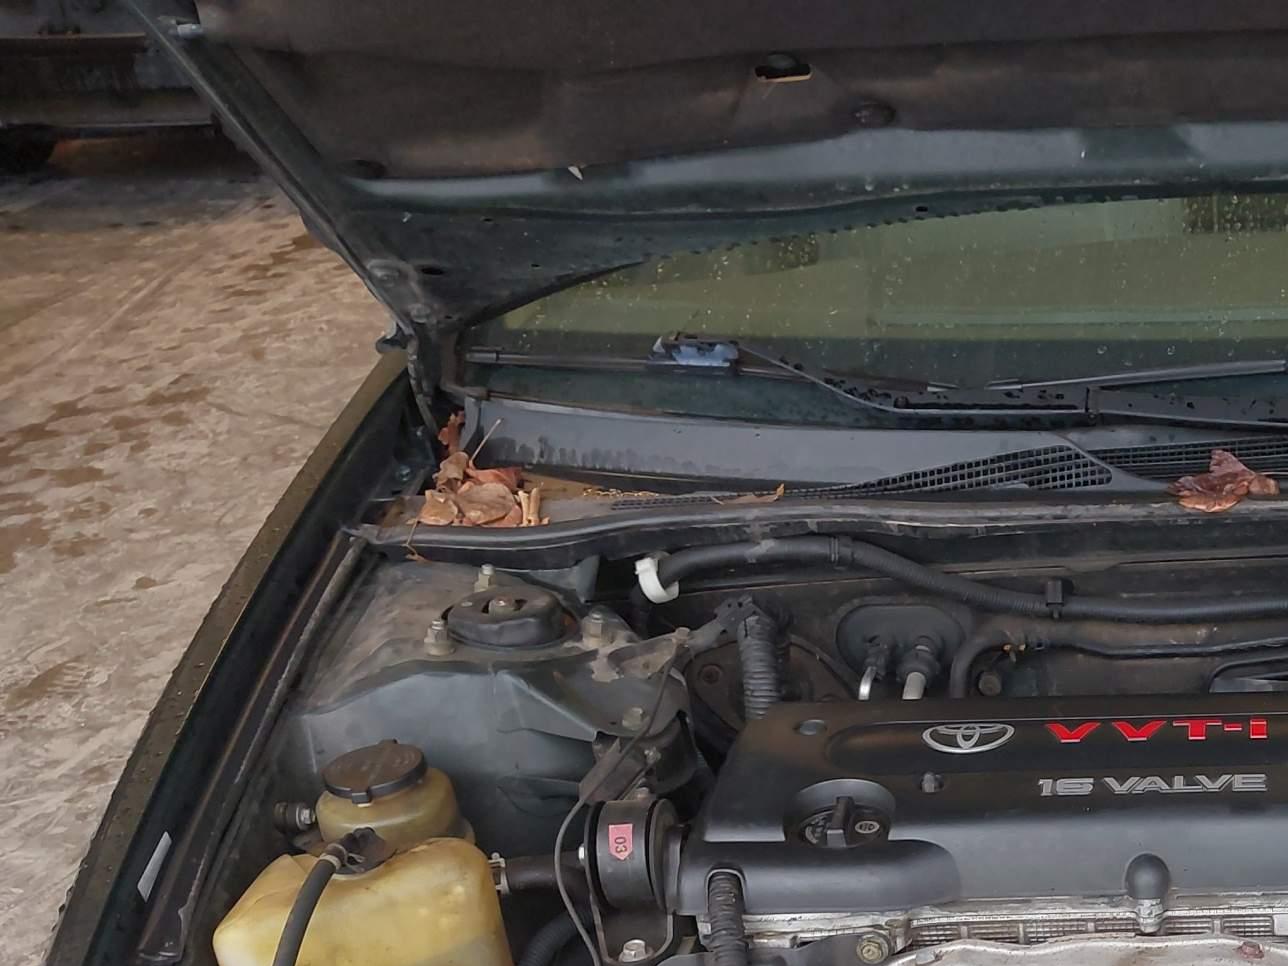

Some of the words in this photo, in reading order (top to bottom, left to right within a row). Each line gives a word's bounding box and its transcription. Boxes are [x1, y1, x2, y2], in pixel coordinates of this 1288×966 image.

[1038, 777, 1095, 796] 16
[1103, 773, 1268, 794] VALVE
[614, 836, 627, 853] 03
